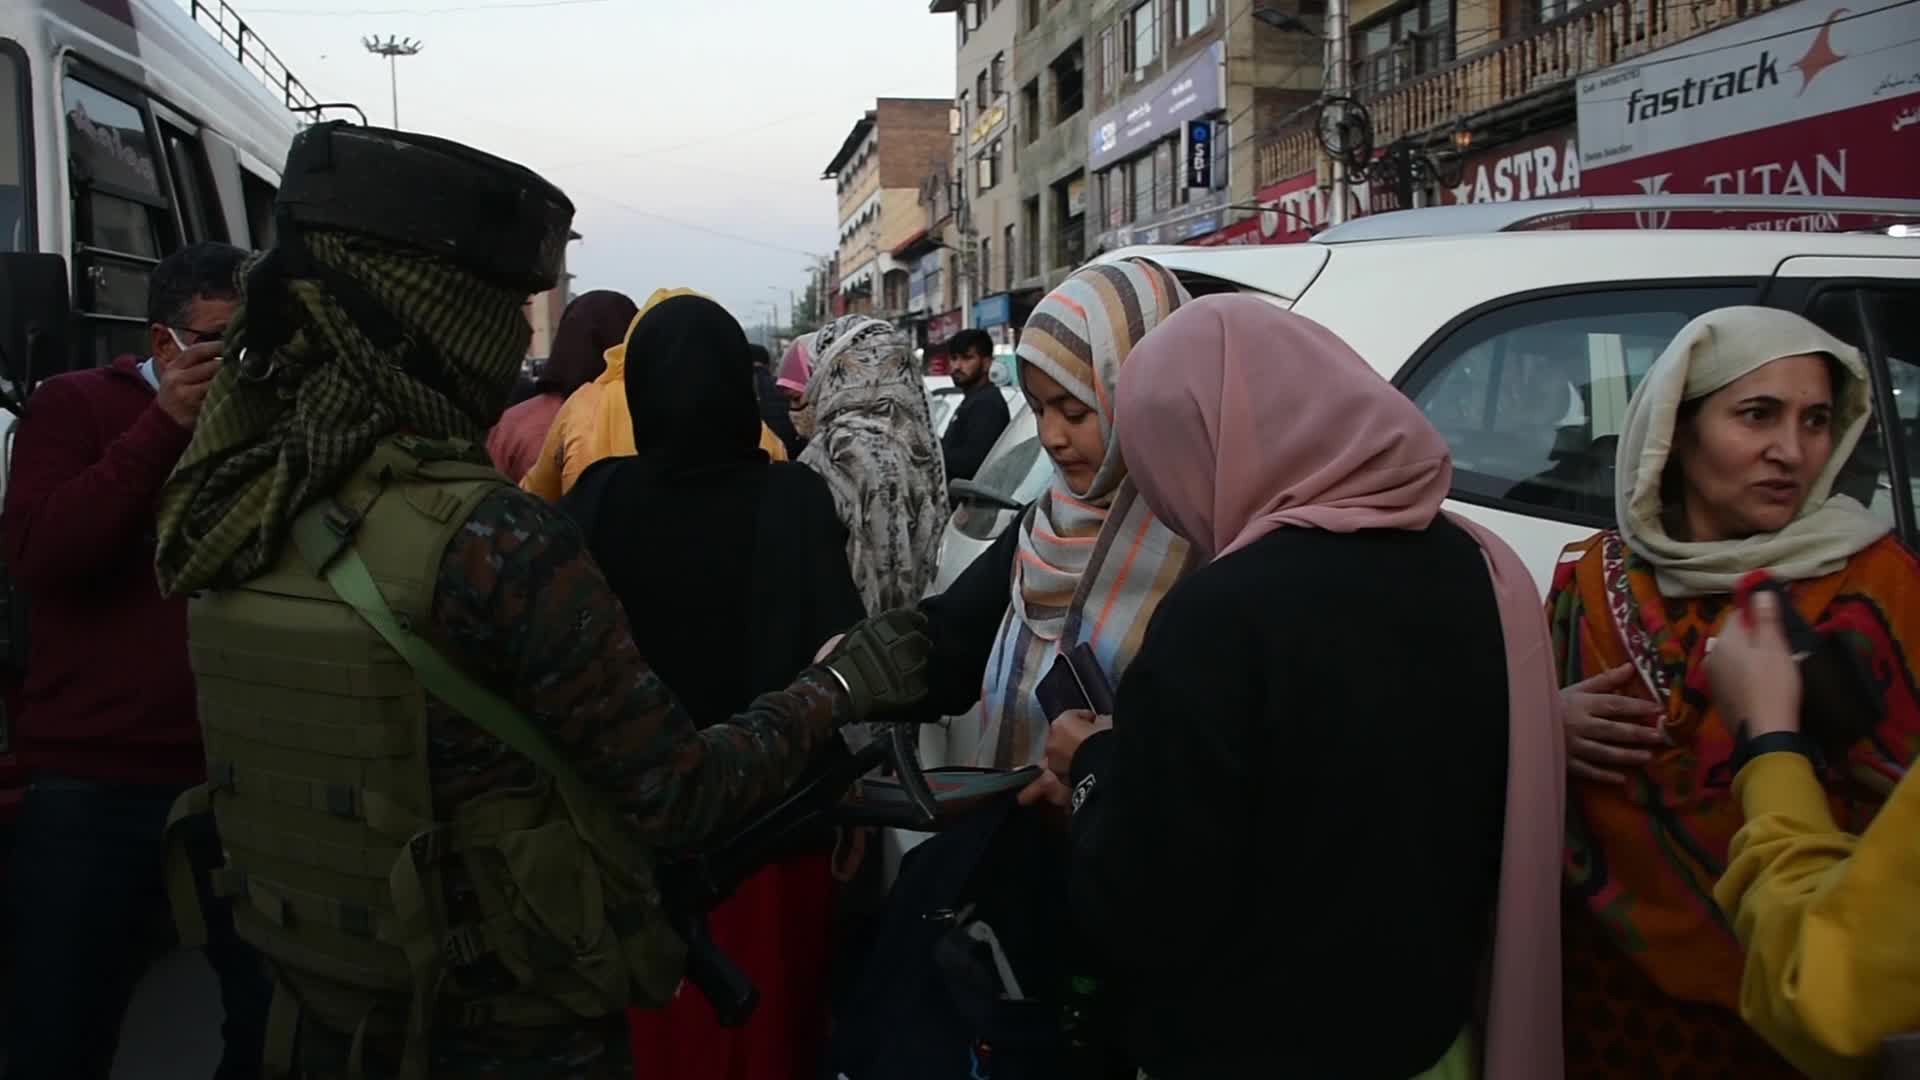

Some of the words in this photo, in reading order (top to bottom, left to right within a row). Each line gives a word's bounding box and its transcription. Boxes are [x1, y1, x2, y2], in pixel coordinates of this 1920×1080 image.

[1627, 51, 1779, 124] fastrack
[1473, 139, 1580, 204] ASTRA
[1704, 149, 1847, 197] TITAN
